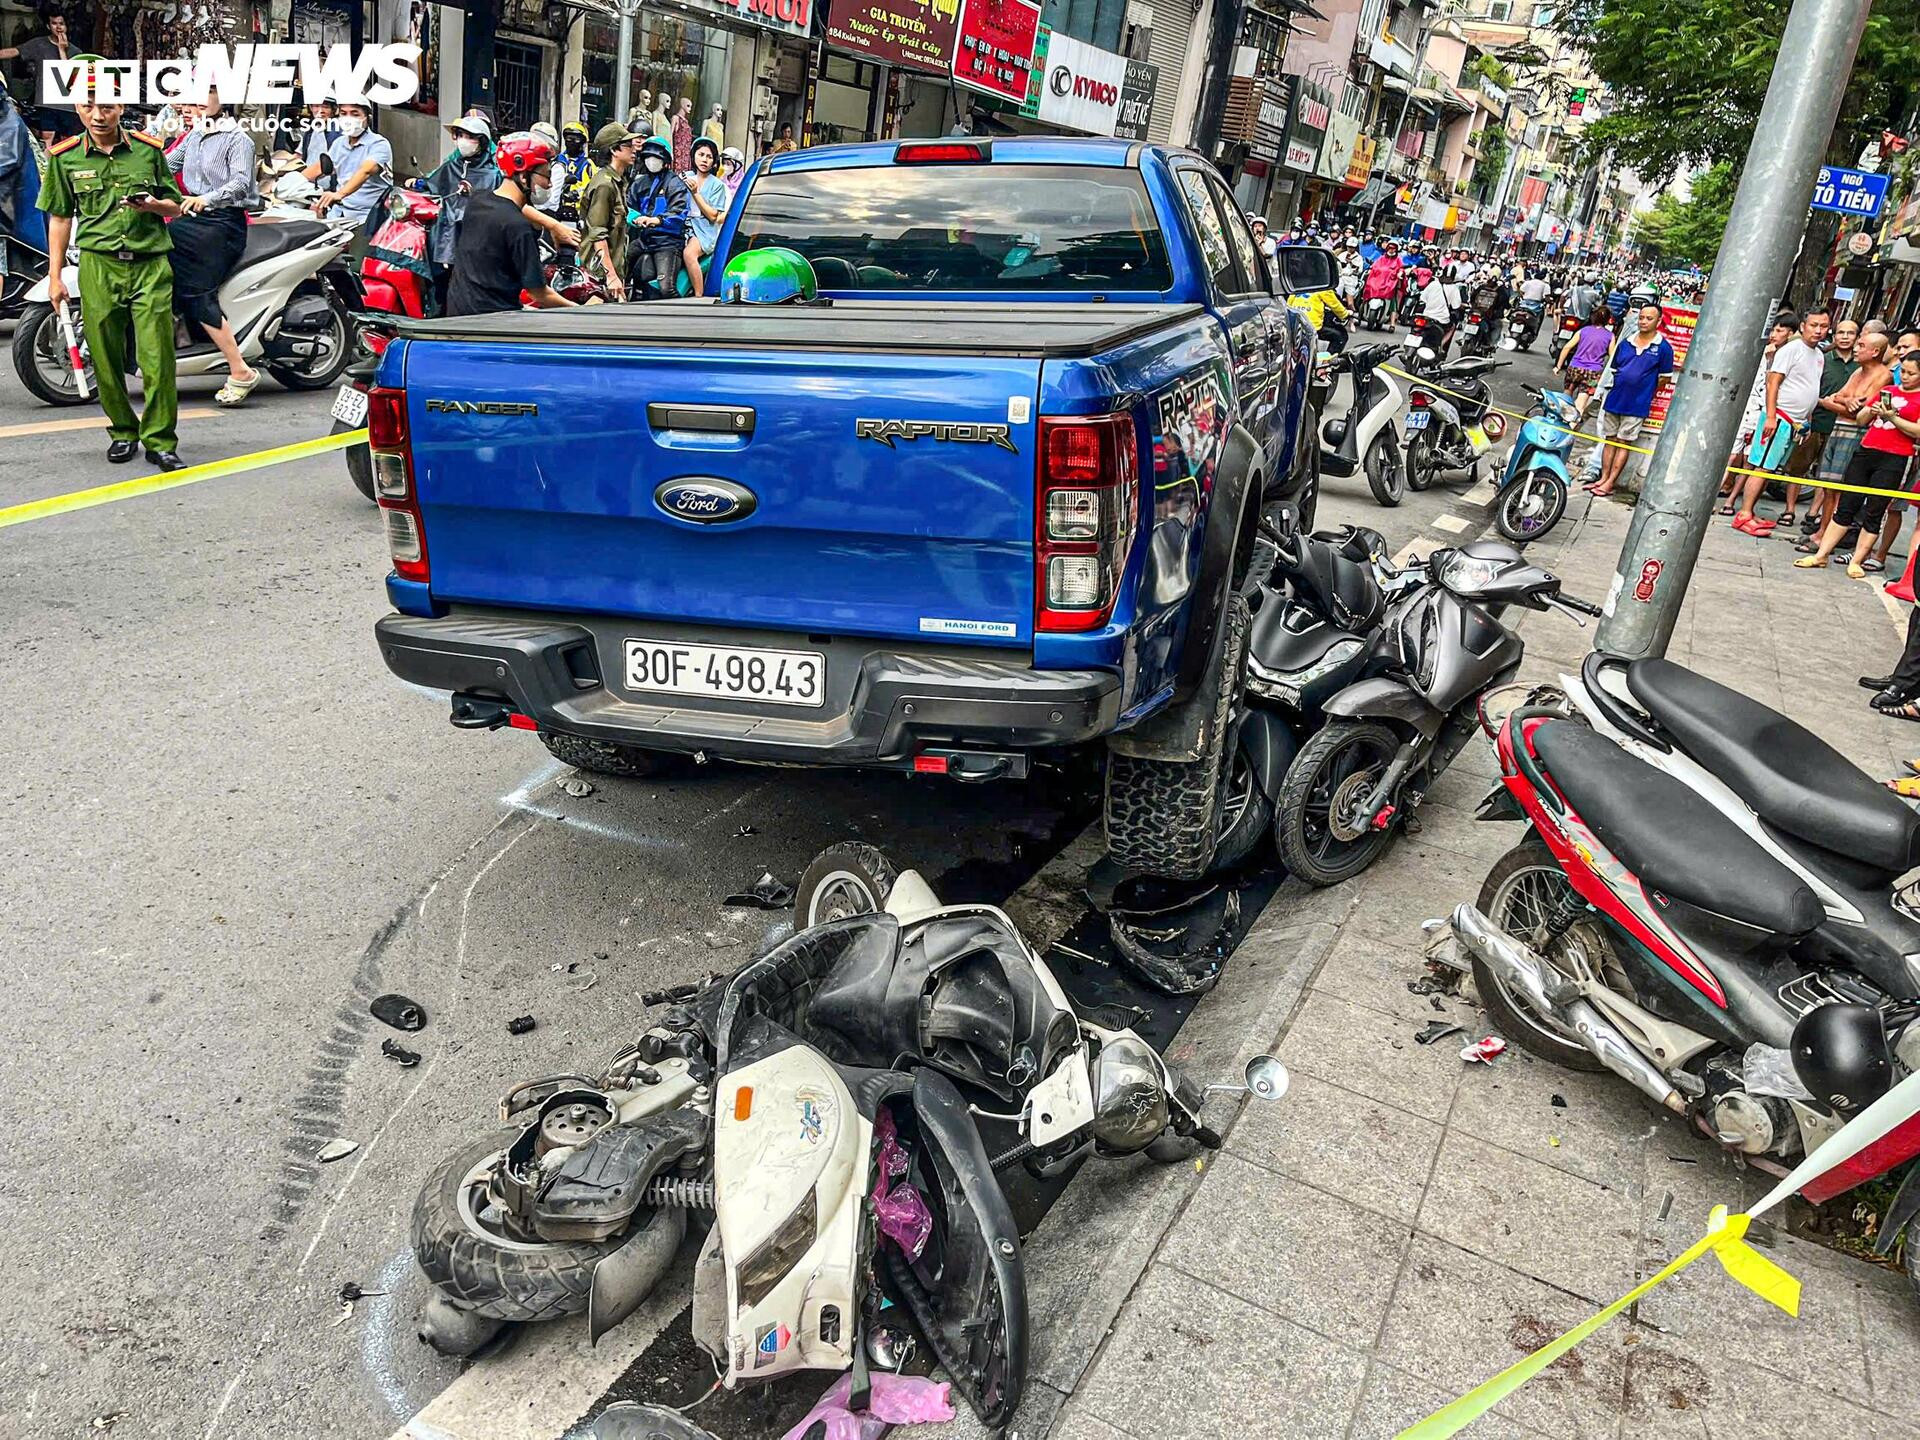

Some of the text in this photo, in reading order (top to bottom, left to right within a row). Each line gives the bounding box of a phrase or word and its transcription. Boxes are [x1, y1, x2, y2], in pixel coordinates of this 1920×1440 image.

[870, 7, 887, 23] GIA
[849, 18, 879, 36] Nước
[898, 33, 920, 49] Trái
[922, 41, 941, 56] Cây
[1072, 75, 1118, 107] KYMCO
[1814, 184, 1835, 204] TÔ
[426, 400, 1019, 453] RANGER RAPTOR
[677, 490, 719, 511] Ford
[945, 621, 978, 630] HANOI
[981, 623, 1009, 631] FORD
[631, 647, 816, 697] 30F-498.43
